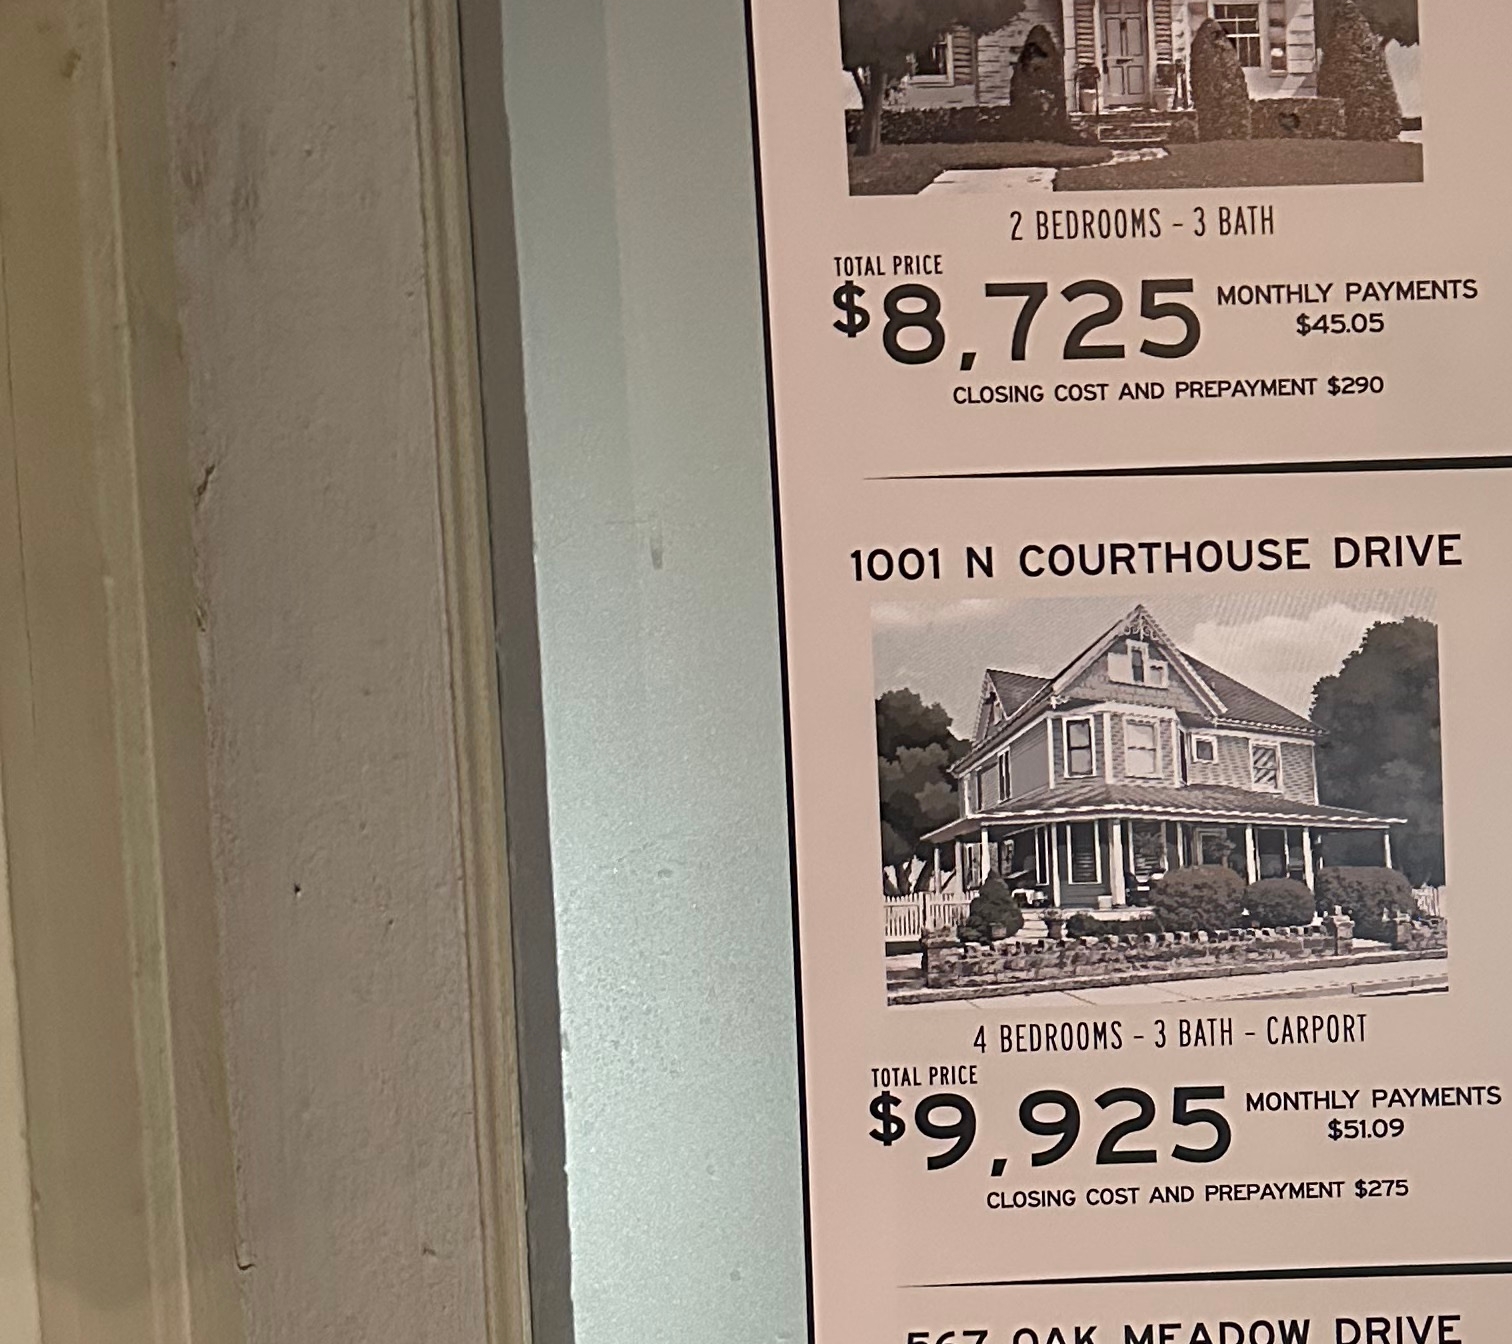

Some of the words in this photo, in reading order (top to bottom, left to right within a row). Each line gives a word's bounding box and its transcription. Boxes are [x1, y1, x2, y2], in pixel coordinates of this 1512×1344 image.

[1009, 210, 1023, 241] 2
[1035, 207, 1162, 241] BEDROOMS
[1193, 206, 1206, 237] 3
[1218, 205, 1274, 236] BATH
[833, 255, 886, 277] TOTAL
[892, 254, 943, 276] PRICE
[1217, 282, 1334, 306] MONTHLY
[1345, 278, 1478, 303] PAYMENTS
[832, 278, 1201, 372] $8,725
[1296, 312, 1385, 337] $45.05
[952, 384, 1045, 405] CLOSING
[1054, 383, 1110, 402] COST
[1118, 381, 1165, 401] AND
[1175, 377, 1318, 399] PREPAYMENT
[1327, 375, 1385, 397] $290
[850, 547, 940, 582] 1001
[966, 546, 994, 579] N
[1019, 537, 1311, 578] COURTHOUSE
[1334, 533, 1463, 569] DRIVE
[973, 1025, 987, 1054] 4
[1000, 1020, 1123, 1053] BEDROOMS
[1154, 1019, 1167, 1049] 3
[1179, 1017, 1233, 1048] BATH
[1266, 1013, 1367, 1045] CARPORT
[871, 1066, 922, 1088] TOTAL
[928, 1064, 978, 1086] PRICE
[1246, 1089, 1360, 1112] MONTHLY
[1371, 1085, 1502, 1109] PAYMENTS
[868, 1085, 1232, 1177] $9,925
[1327, 1117, 1405, 1142] $51.09
[986, 1189, 1076, 1210] CLOSING
[1085, 1187, 1140, 1206] COST
[1148, 1185, 1195, 1204] AND
[1205, 1180, 1346, 1202] PREPAYMENT
[1354, 1178, 1409, 1199] $275
